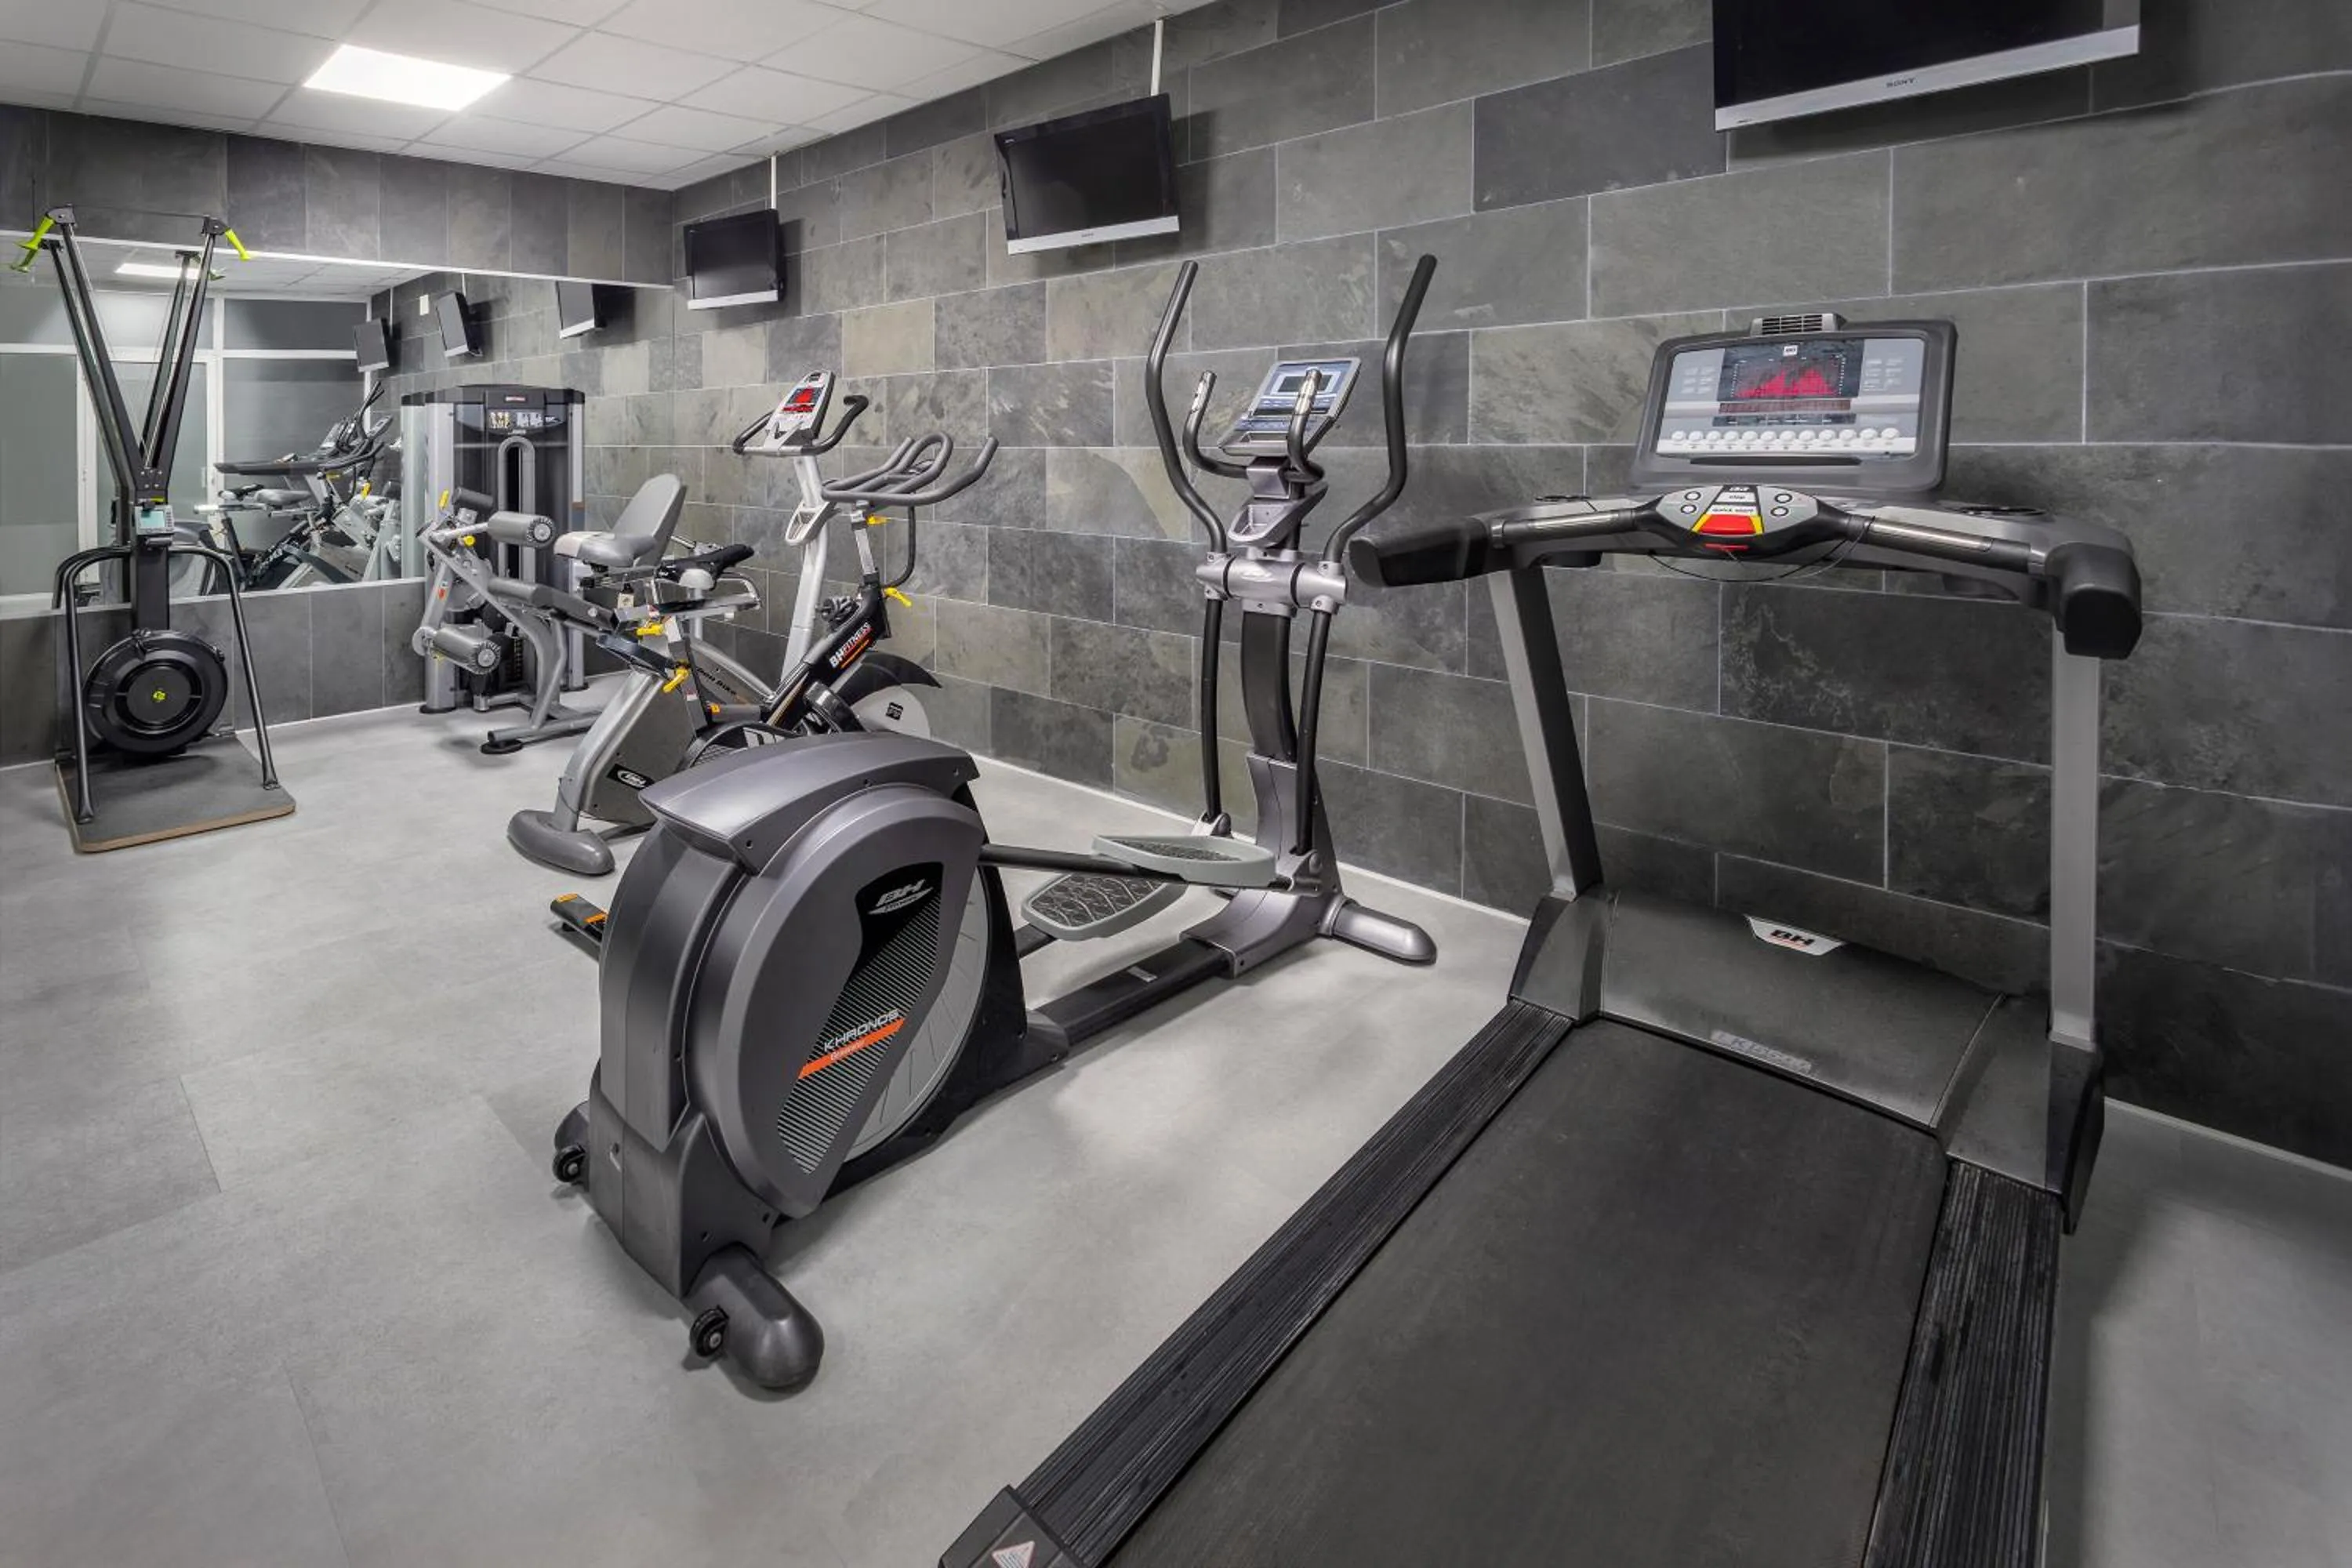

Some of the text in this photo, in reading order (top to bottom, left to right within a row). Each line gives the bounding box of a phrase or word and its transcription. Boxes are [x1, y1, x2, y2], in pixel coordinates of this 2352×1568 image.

[1886, 78, 1917, 88] SONY
[1771, 929, 1816, 946] BH
[824, 1007, 900, 1053] KHRONOS
